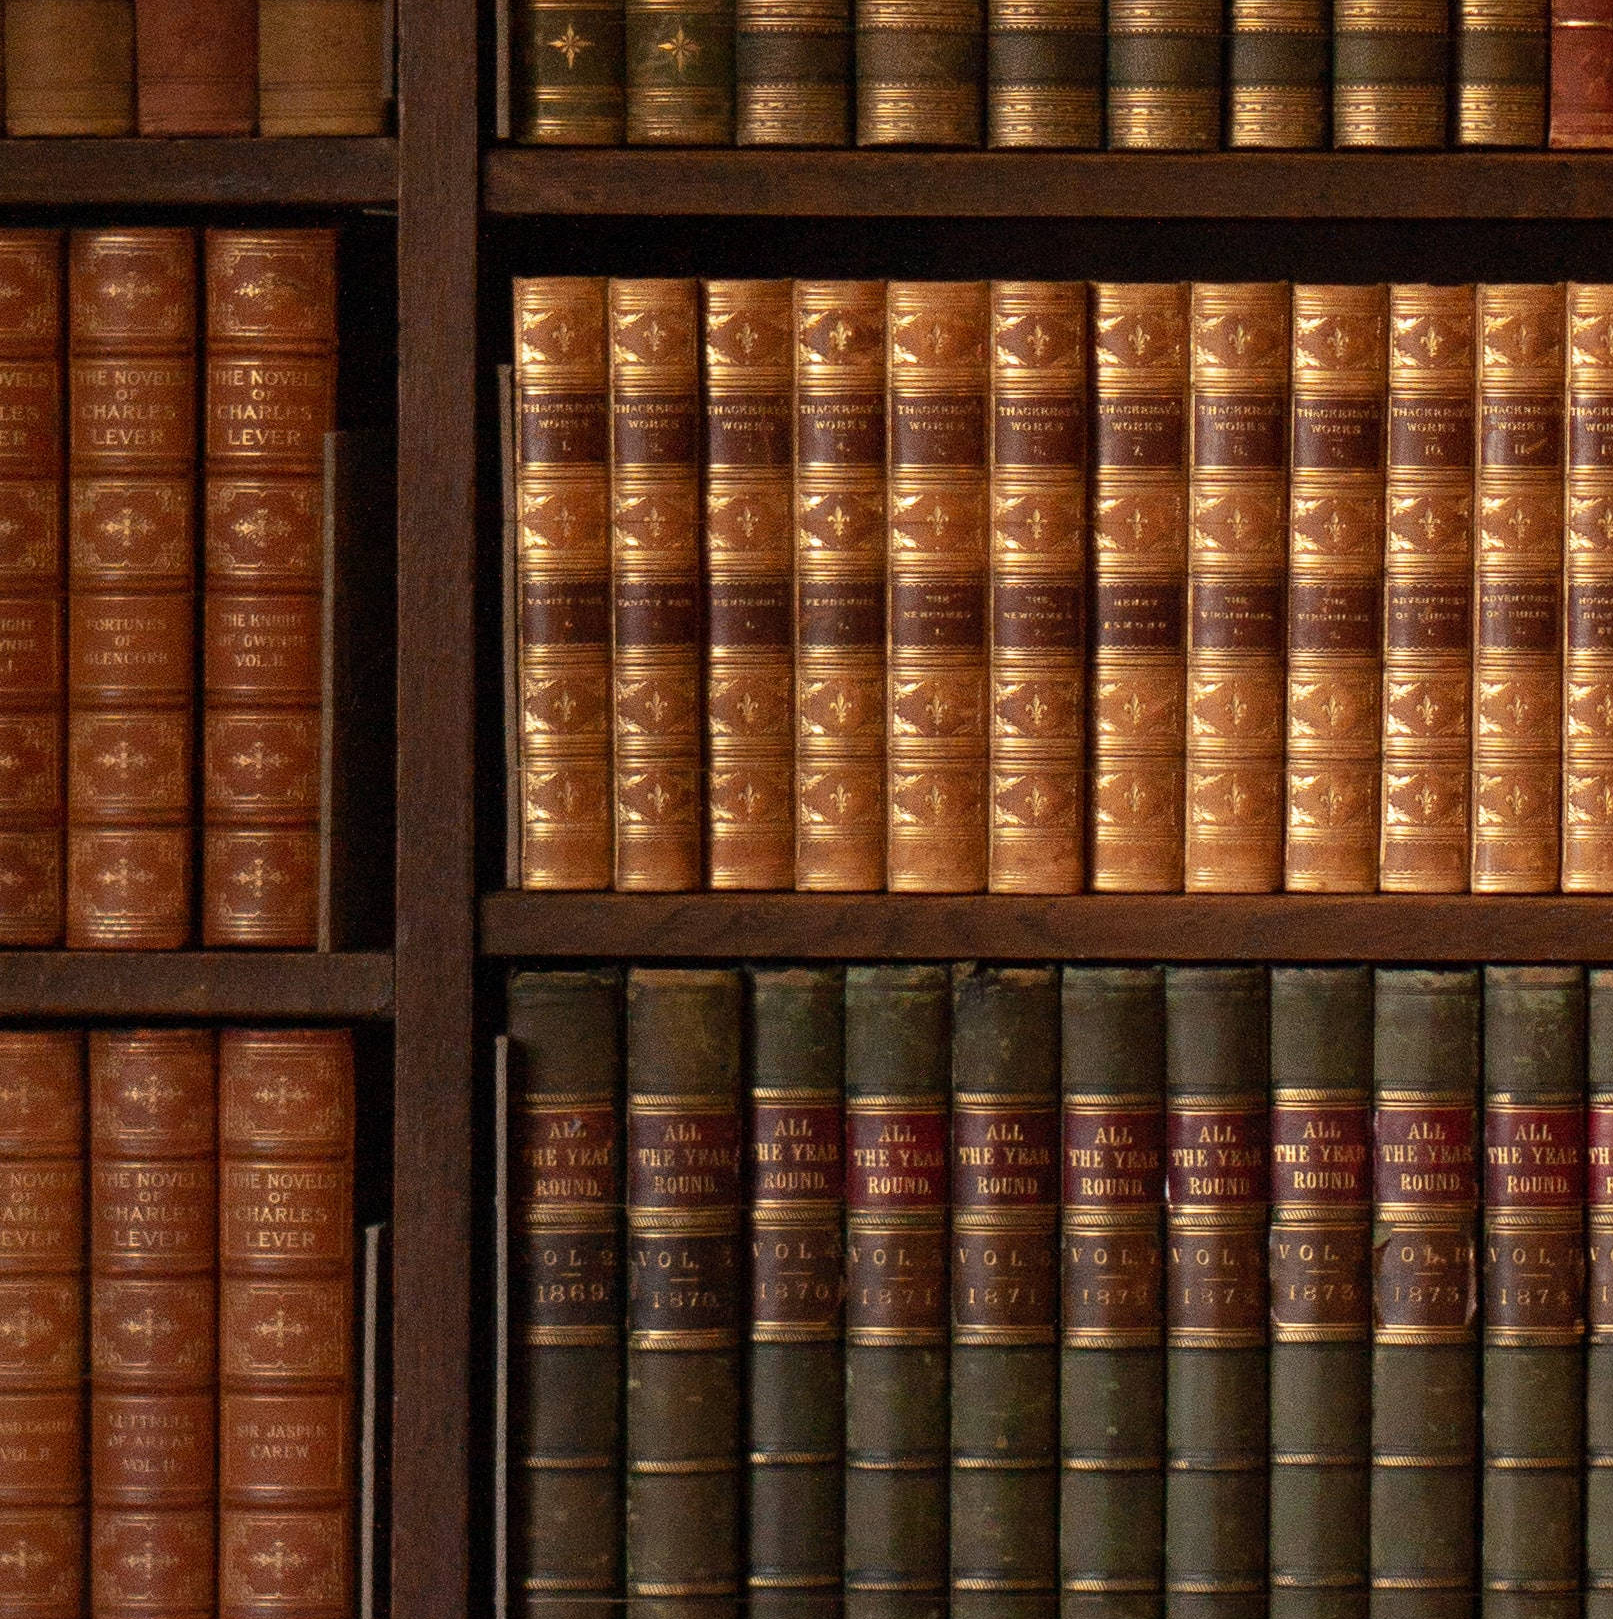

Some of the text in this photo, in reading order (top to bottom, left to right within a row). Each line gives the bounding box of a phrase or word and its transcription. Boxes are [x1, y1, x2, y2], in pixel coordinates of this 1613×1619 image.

[252, 390, 273, 400] OF
[94, 431, 163, 445] LEVER
[229, 430, 300, 444] LEVER
[879, 1125, 916, 1142] ALL
[986, 1125, 1024, 1141] ALL
[1094, 1127, 1132, 1145] ALL
[1407, 1123, 1445, 1139] ALL
[1515, 1125, 1552, 1141] ALL
[855, 1150, 889, 1166] THE
[959, 1147, 995, 1165] THE
[1070, 1150, 1103, 1167] THE
[1383, 1145, 1417, 1162] THE
[1489, 1147, 1522, 1164] THE
[268, 1174, 336, 1189] NOVELS
[269, 1192, 291, 1203] OF
[247, 1233, 314, 1246] LEVER
